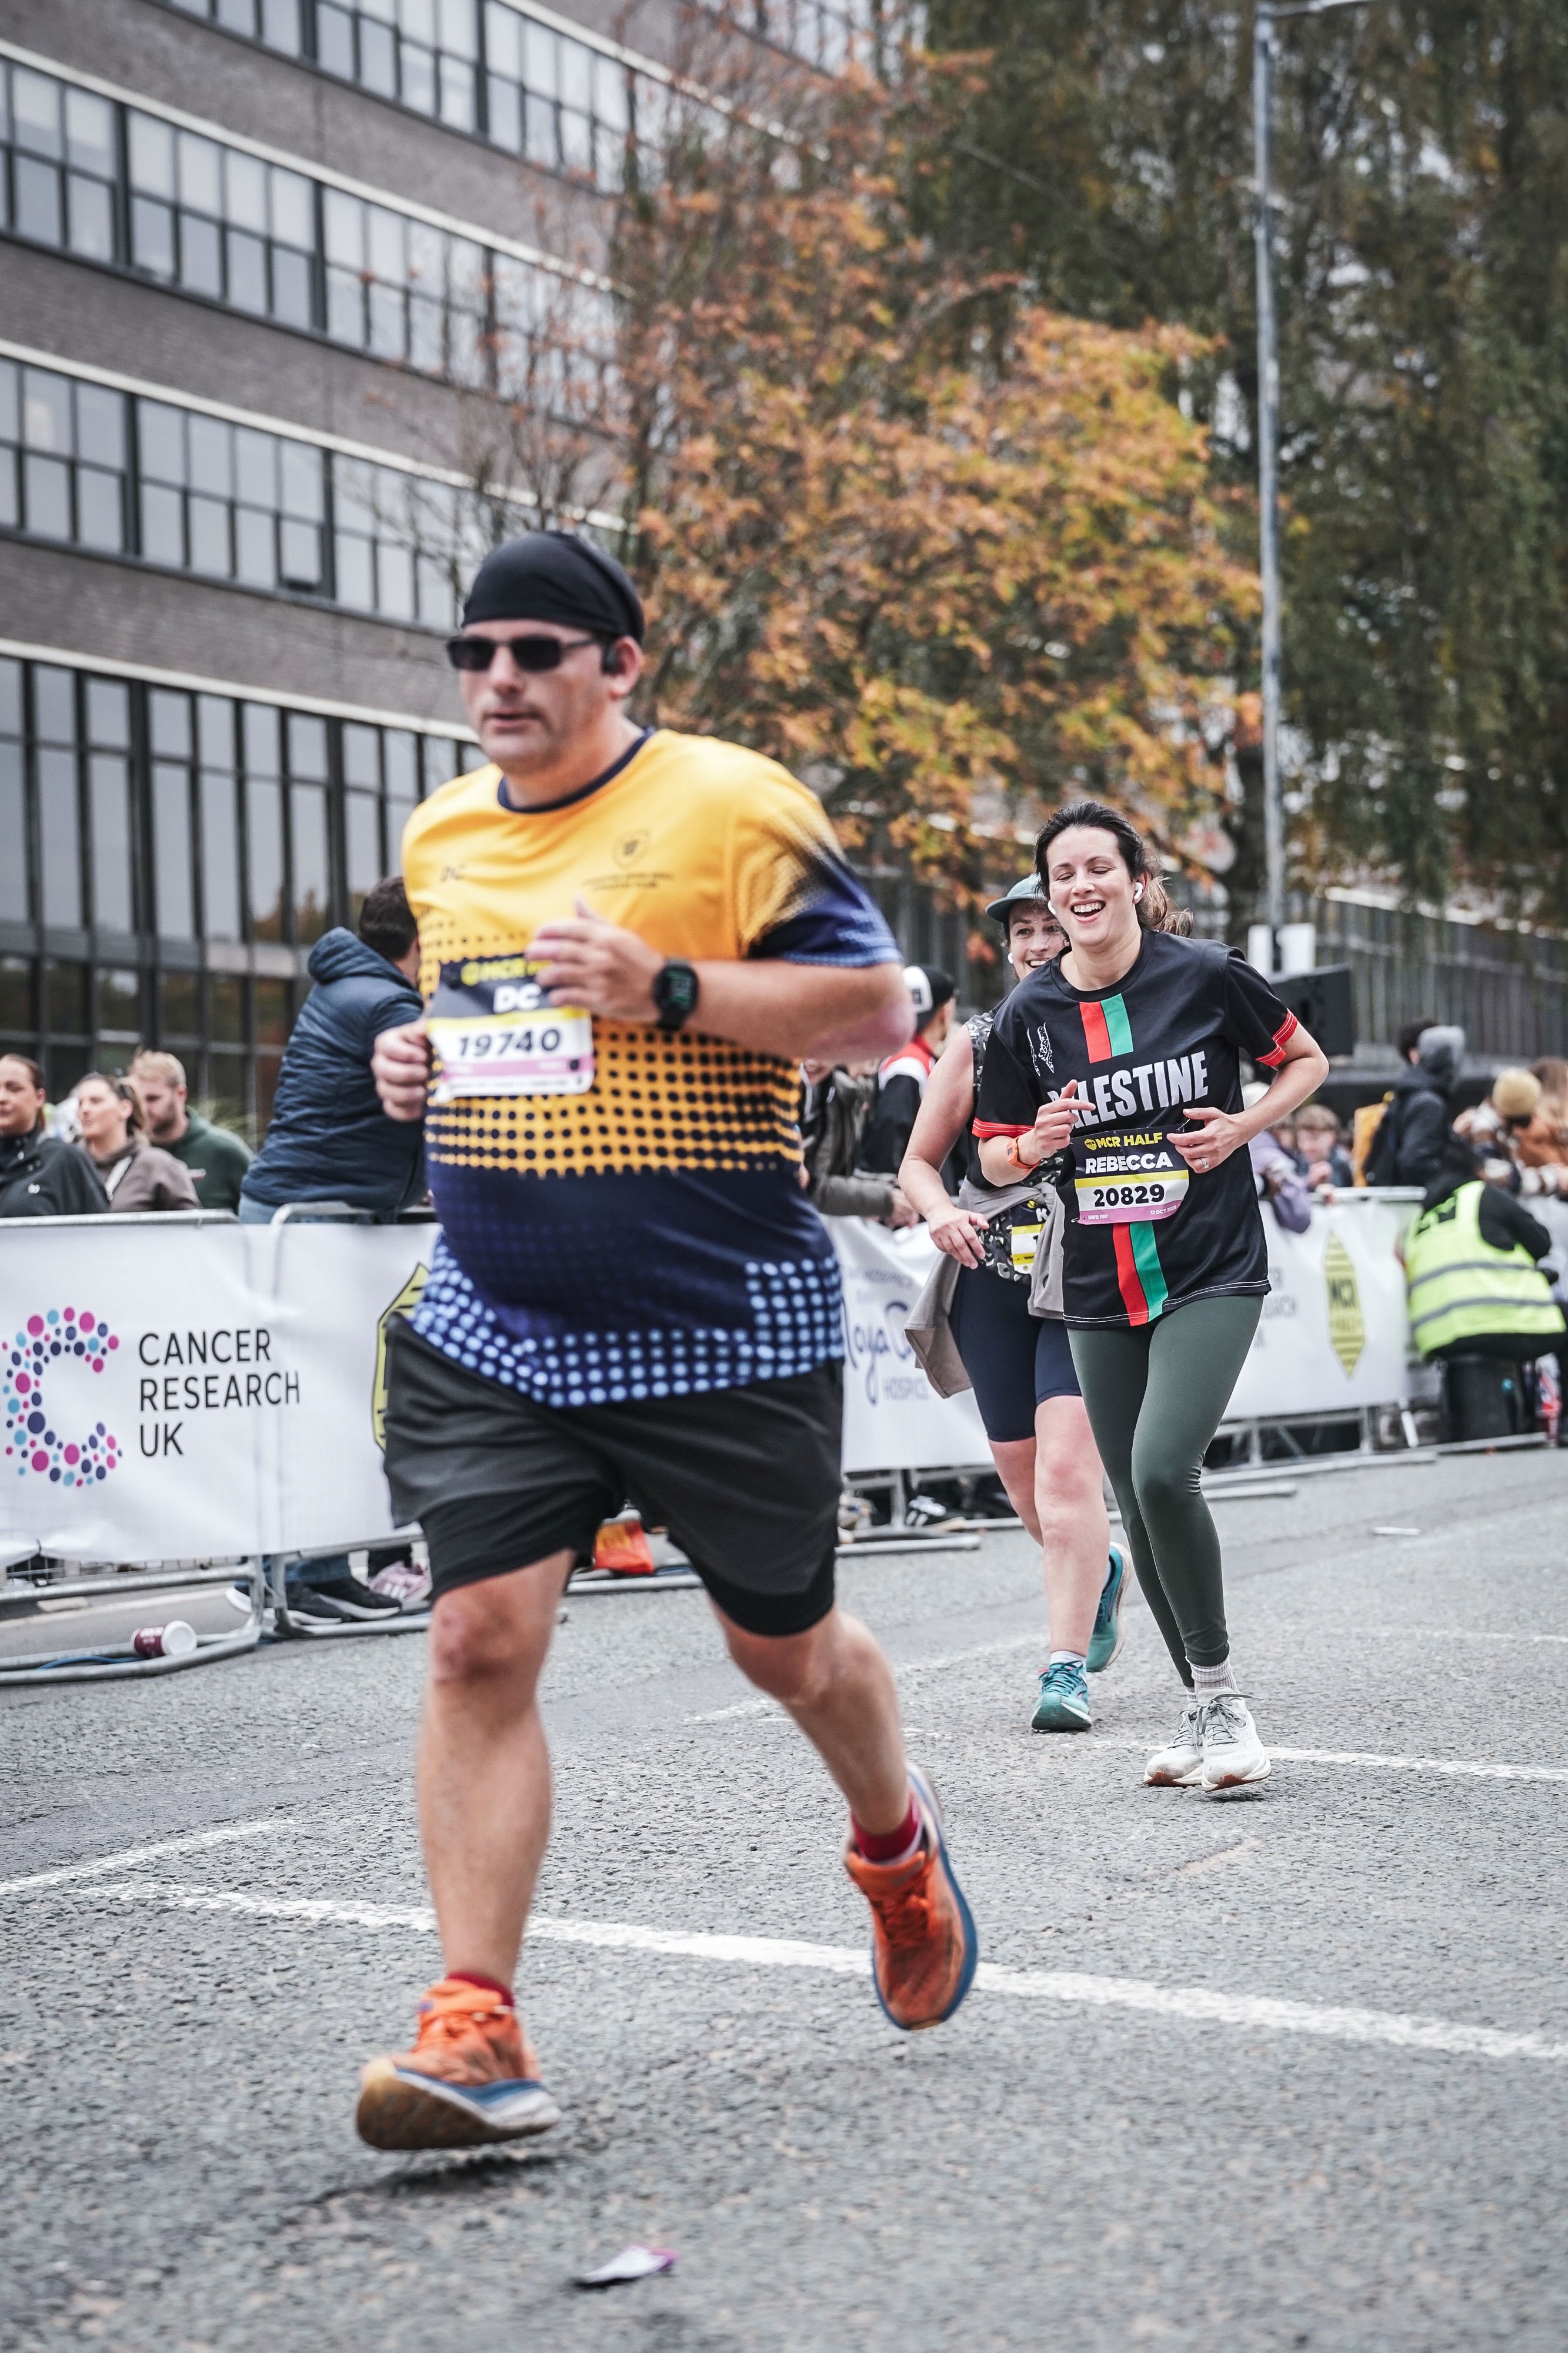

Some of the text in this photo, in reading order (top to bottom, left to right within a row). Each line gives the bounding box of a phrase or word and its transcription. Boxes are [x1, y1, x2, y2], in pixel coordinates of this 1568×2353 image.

[493, 982, 542, 1014] DC
[459, 1028, 560, 1057] 19740
[1096, 1132, 1163, 1148] MCR HALF
[1086, 1152, 1173, 1174] REBECCA
[1093, 1184, 1165, 1207] 20829
[139, 1328, 271, 1366] CANCER
[140, 1370, 299, 1411] RESEARCH
[140, 1421, 184, 1457] UK
